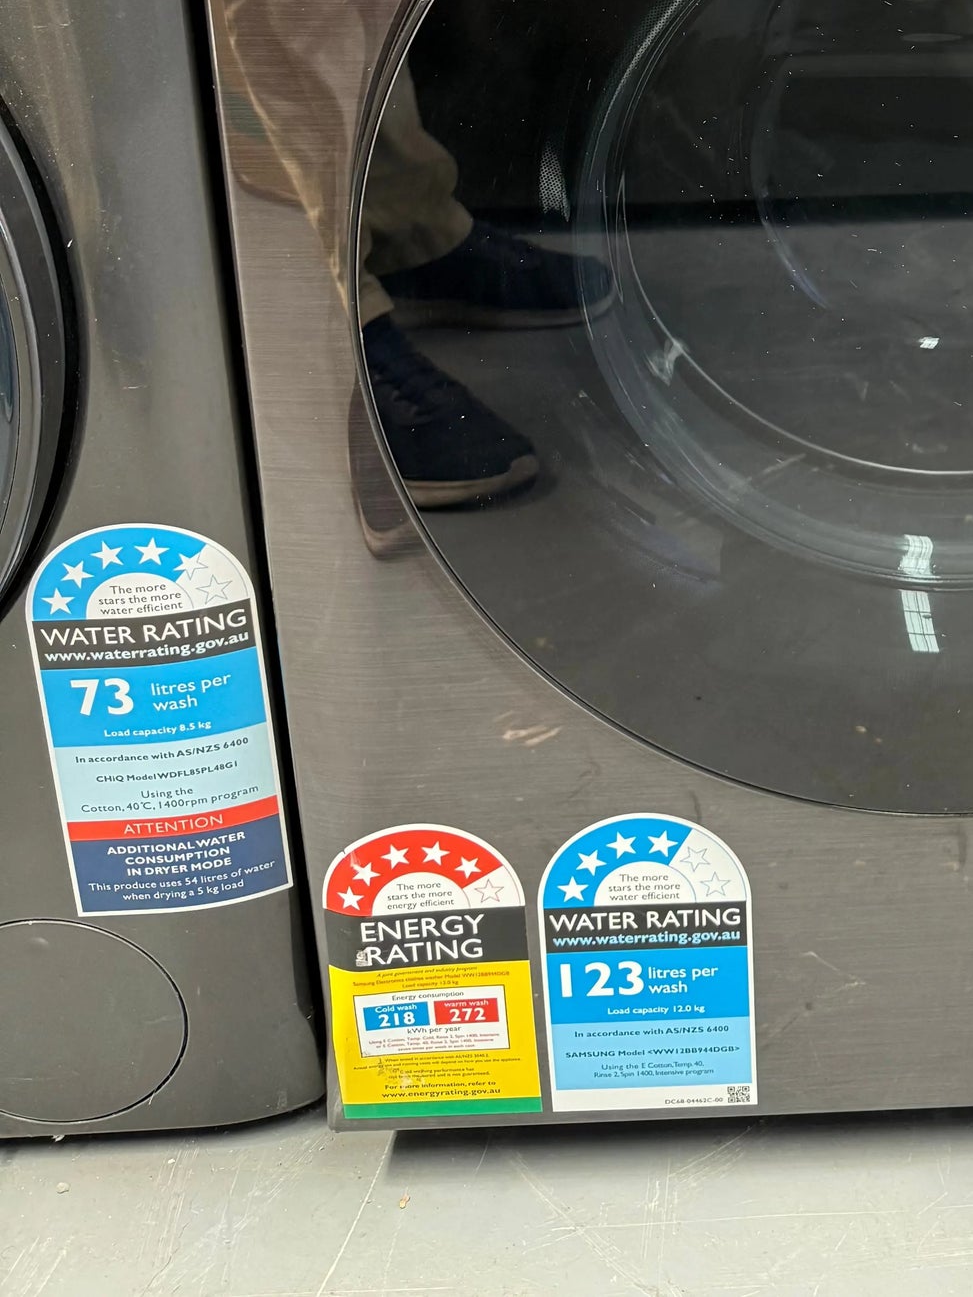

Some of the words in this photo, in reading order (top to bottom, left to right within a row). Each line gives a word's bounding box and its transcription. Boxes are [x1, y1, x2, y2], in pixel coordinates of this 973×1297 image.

[110, 585, 132, 594] The
[135, 583, 166, 592] more
[98, 596, 125, 605] stars
[129, 594, 147, 603] the
[150, 592, 181, 601] more
[101, 607, 133, 615] water
[136, 602, 183, 613] efficient
[40, 627, 136, 646] WATER
[143, 608, 247, 643] RATING
[45, 631, 249, 662] www.waterrating.gov.au
[70, 678, 134, 716] 73
[151, 682, 196, 696] litres
[202, 674, 231, 693] per
[153, 696, 198, 711] wash
[104, 729, 130, 737] Load
[133, 727, 177, 737] capacity
[198, 721, 211, 729] kg
[75, 756, 85, 764] In
[88, 754, 148, 763] accordance
[177, 744, 220, 757] AS/NZS
[223, 737, 249, 748] 6400
[96, 775, 124, 783] CHiQ
[141, 790, 172, 799] Using
[175, 787, 193, 795] the
[159, 797, 208, 810] 1400rpm
[211, 785, 259, 804] program
[124, 814, 224, 835] ATTENTION
[107, 840, 195, 855] ADDITIONAL
[196, 831, 246, 848] WATER
[125, 846, 230, 865] CONSUMPTION
[127, 868, 143, 876] IN
[145, 864, 188, 876] DRYER
[191, 857, 232, 872] MODE
[88, 882, 111, 891] This
[114, 879, 157, 891] produce
[159, 879, 182, 888] uses
[185, 877, 198, 885] 54
[201, 873, 228, 883] litres
[231, 869, 242, 878] of
[244, 860, 275, 874] water
[123, 891, 151, 900] when
[154, 888, 187, 900] drying
[198, 887, 203, 895] 5
[206, 885, 219, 895] kg
[221, 879, 244, 891] load
[549, 912, 638, 931] WATER
[646, 908, 741, 928] RATING
[360, 914, 484, 942] ENERGY
[553, 931, 741, 947] www.waterrating.gov.au
[367, 939, 483, 966] RATING
[560, 961, 644, 997] 123
[649, 967, 686, 979] litres
[692, 967, 718, 981] per
[649, 982, 688, 994] wash
[392, 994, 416, 1002] Energy
[418, 991, 464, 999] consumption
[450, 1008, 486, 1021] 272
[607, 1007, 630, 1015] Load
[633, 1006, 669, 1015] capacity
[694, 1005, 705, 1013] kg
[378, 1012, 416, 1027] 218
[429, 1026, 442, 1035] per
[444, 1025, 462, 1033] year
[586, 1029, 640, 1037] accordance
[643, 1027, 664, 1035] with
[666, 1026, 704, 1034] AS/NZS
[382, 1088, 501, 1098] www.energyrating.gov.au
